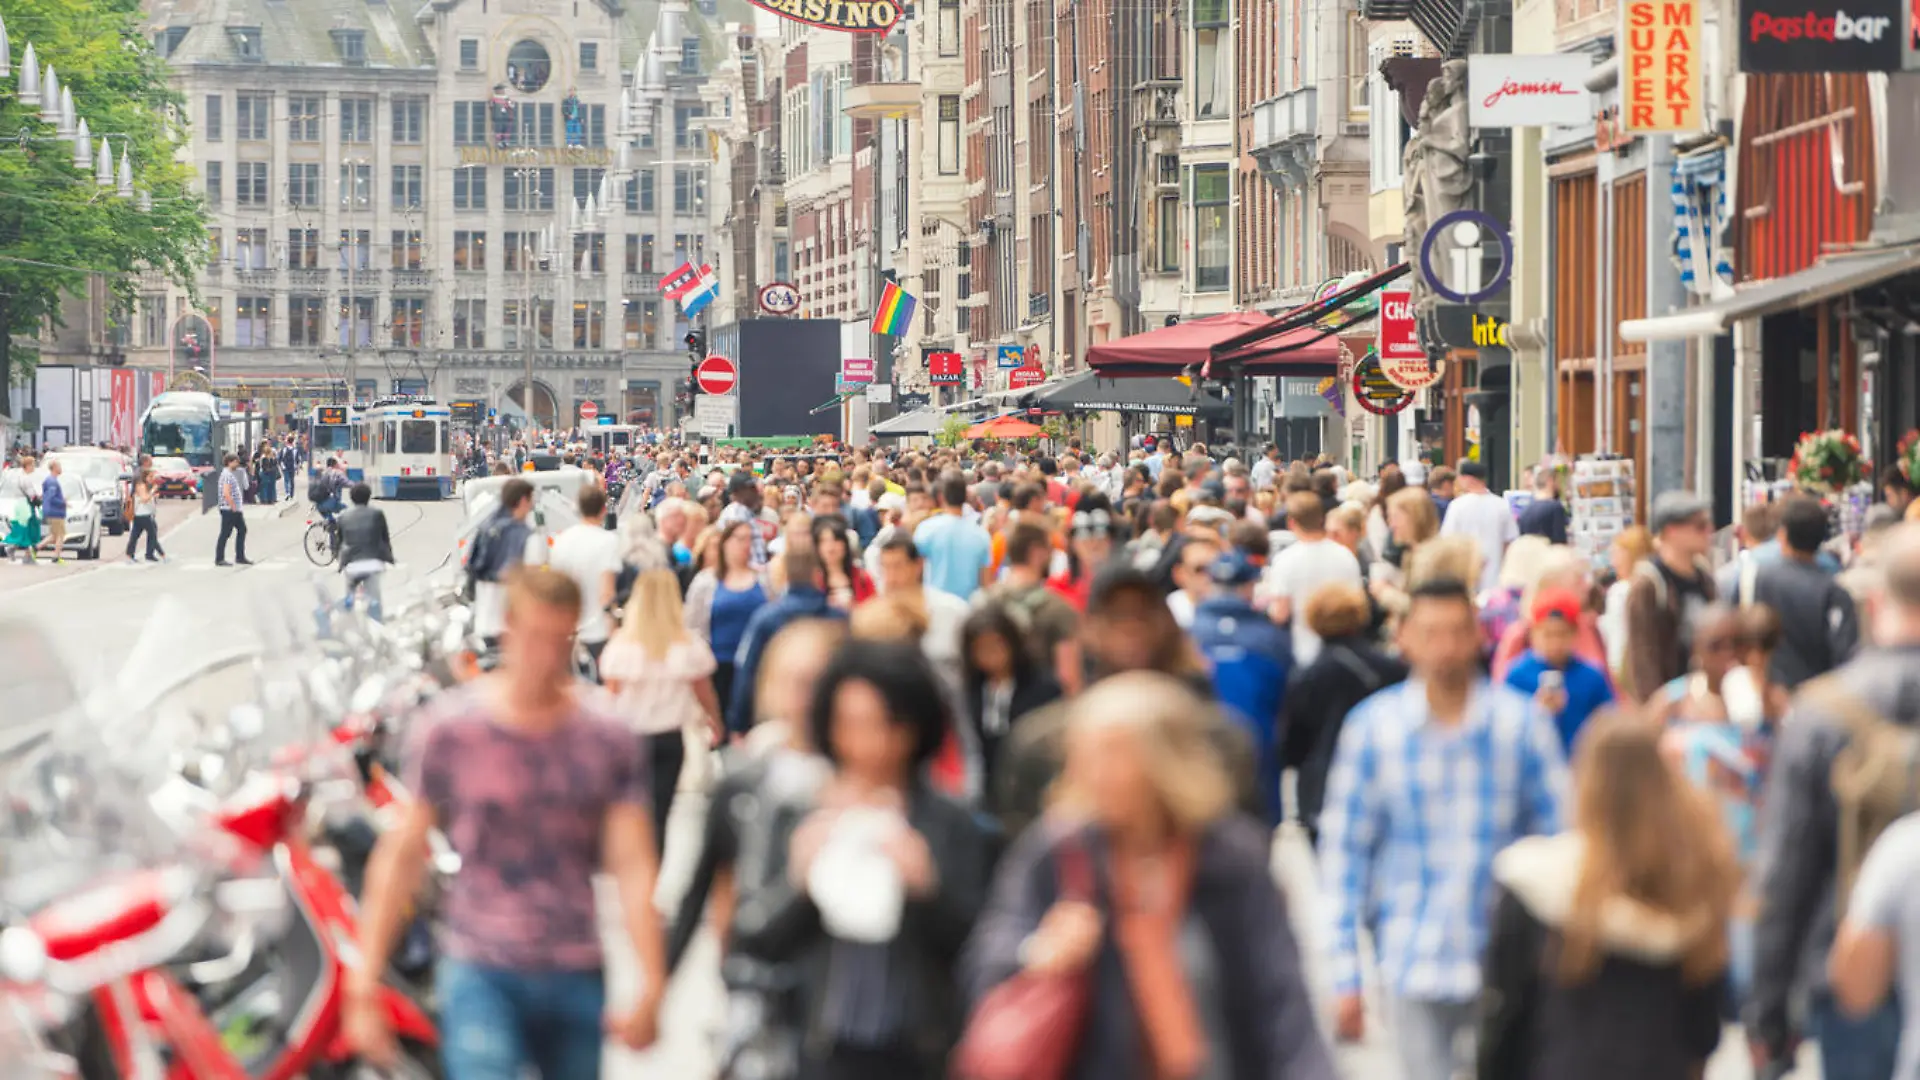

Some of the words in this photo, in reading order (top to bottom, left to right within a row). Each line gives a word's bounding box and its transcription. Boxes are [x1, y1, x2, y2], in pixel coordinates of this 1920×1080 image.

[1483, 76, 1579, 107] jamin
[1630, 3, 1656, 127] SUPER
[1663, 3, 1692, 126] MARKT
[1147, 404, 1197, 413] RESTAURANT
